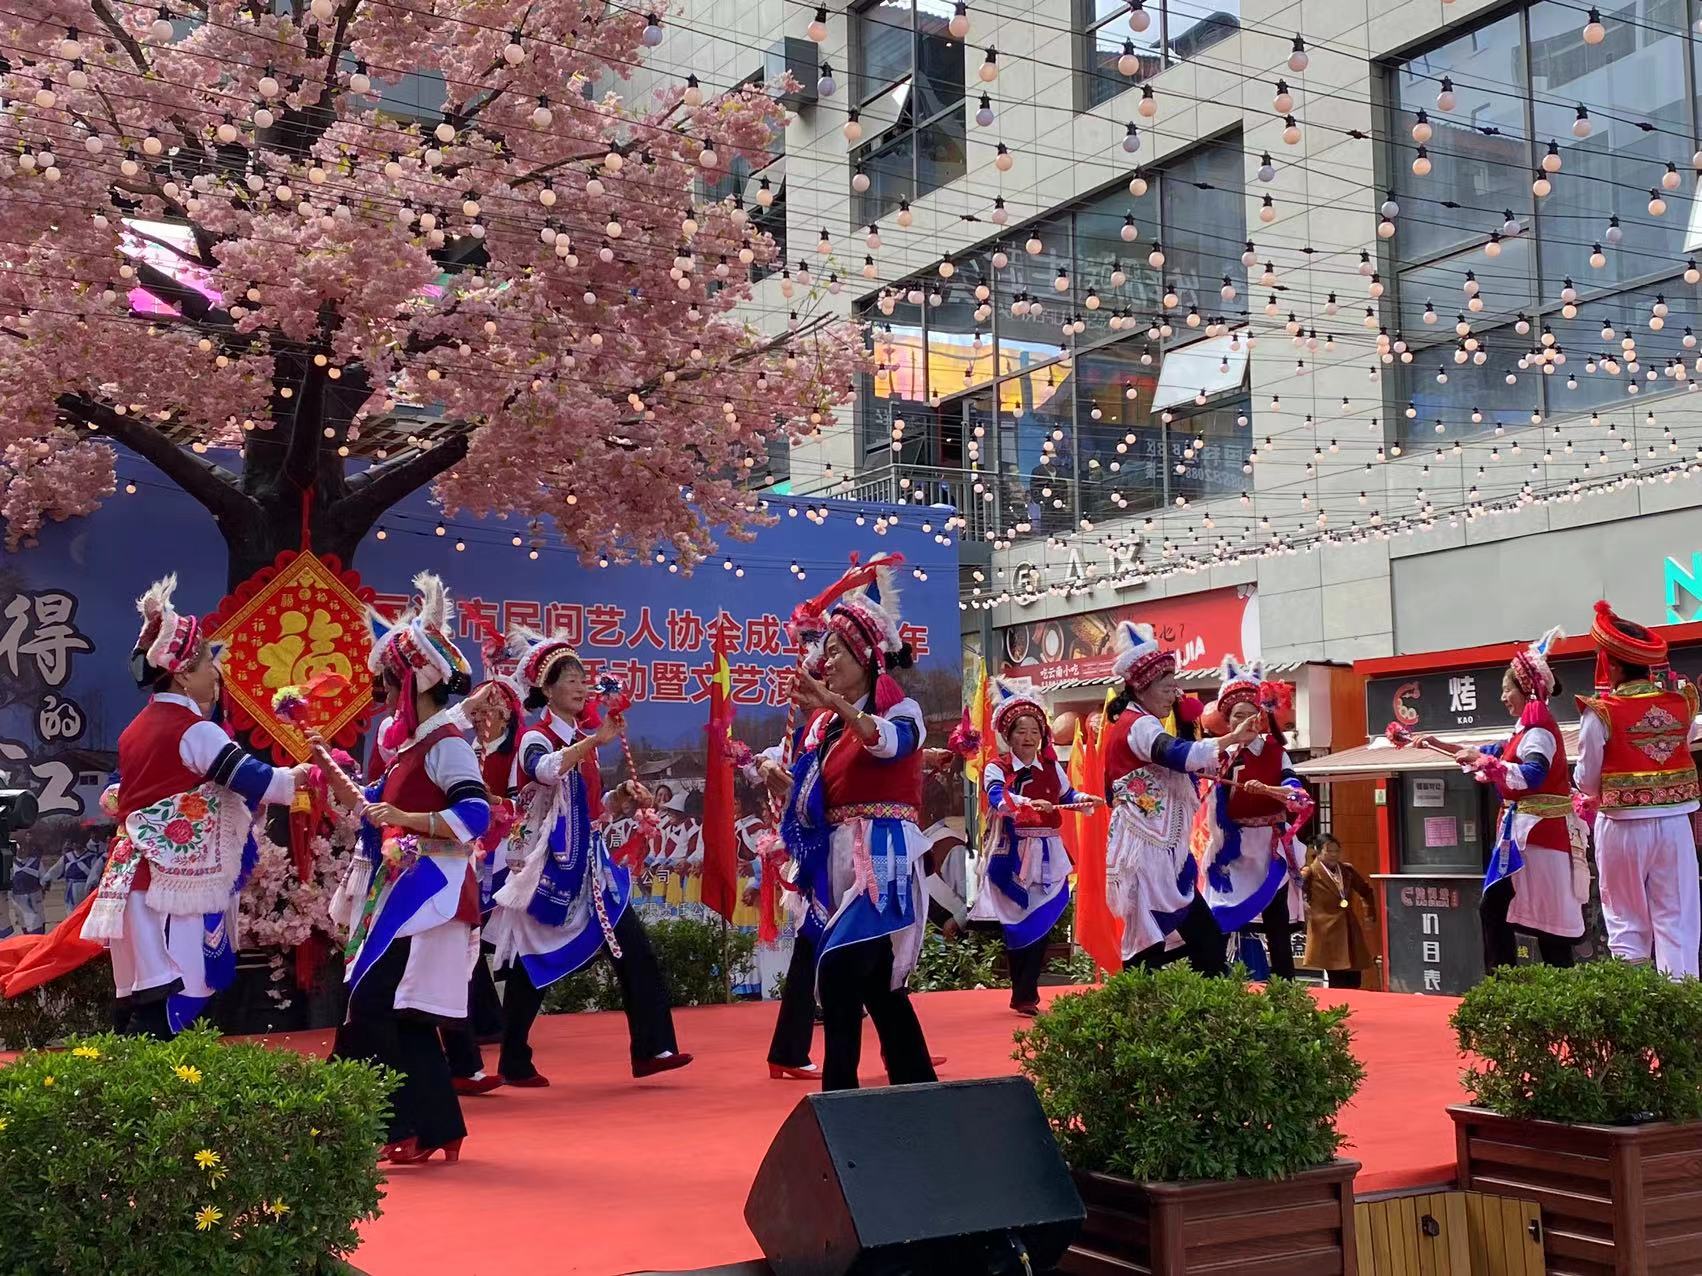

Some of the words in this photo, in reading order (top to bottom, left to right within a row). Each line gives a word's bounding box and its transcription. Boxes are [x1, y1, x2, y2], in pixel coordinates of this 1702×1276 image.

[257, 608, 354, 698] 福
[1448, 675, 1477, 712] 烤
[1457, 715, 1474, 724] KAO
